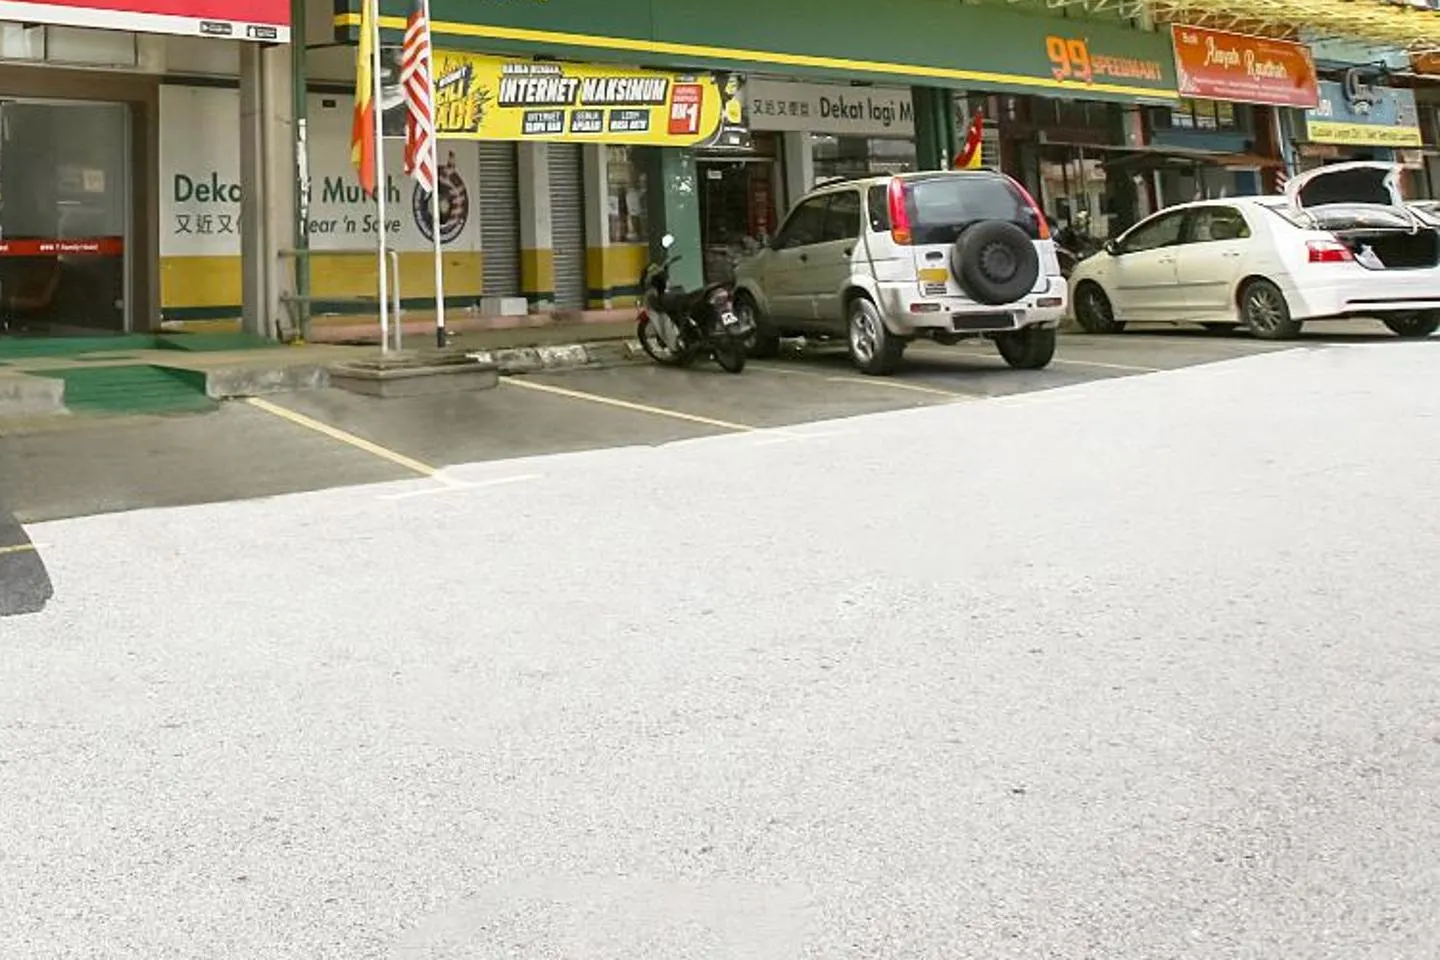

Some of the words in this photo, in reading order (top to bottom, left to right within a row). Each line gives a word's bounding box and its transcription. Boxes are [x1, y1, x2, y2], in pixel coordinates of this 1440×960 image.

[1045, 34, 1092, 82] 99
[499, 76, 579, 104] INTERNET
[581, 77, 668, 105] MAKSIMUM
[820, 95, 863, 120] Dekat
[868, 98, 895, 127] lagi
[174, 171, 242, 203] Deka
[174, 213, 242, 235] 又近又
[307, 217, 338, 233] ear
